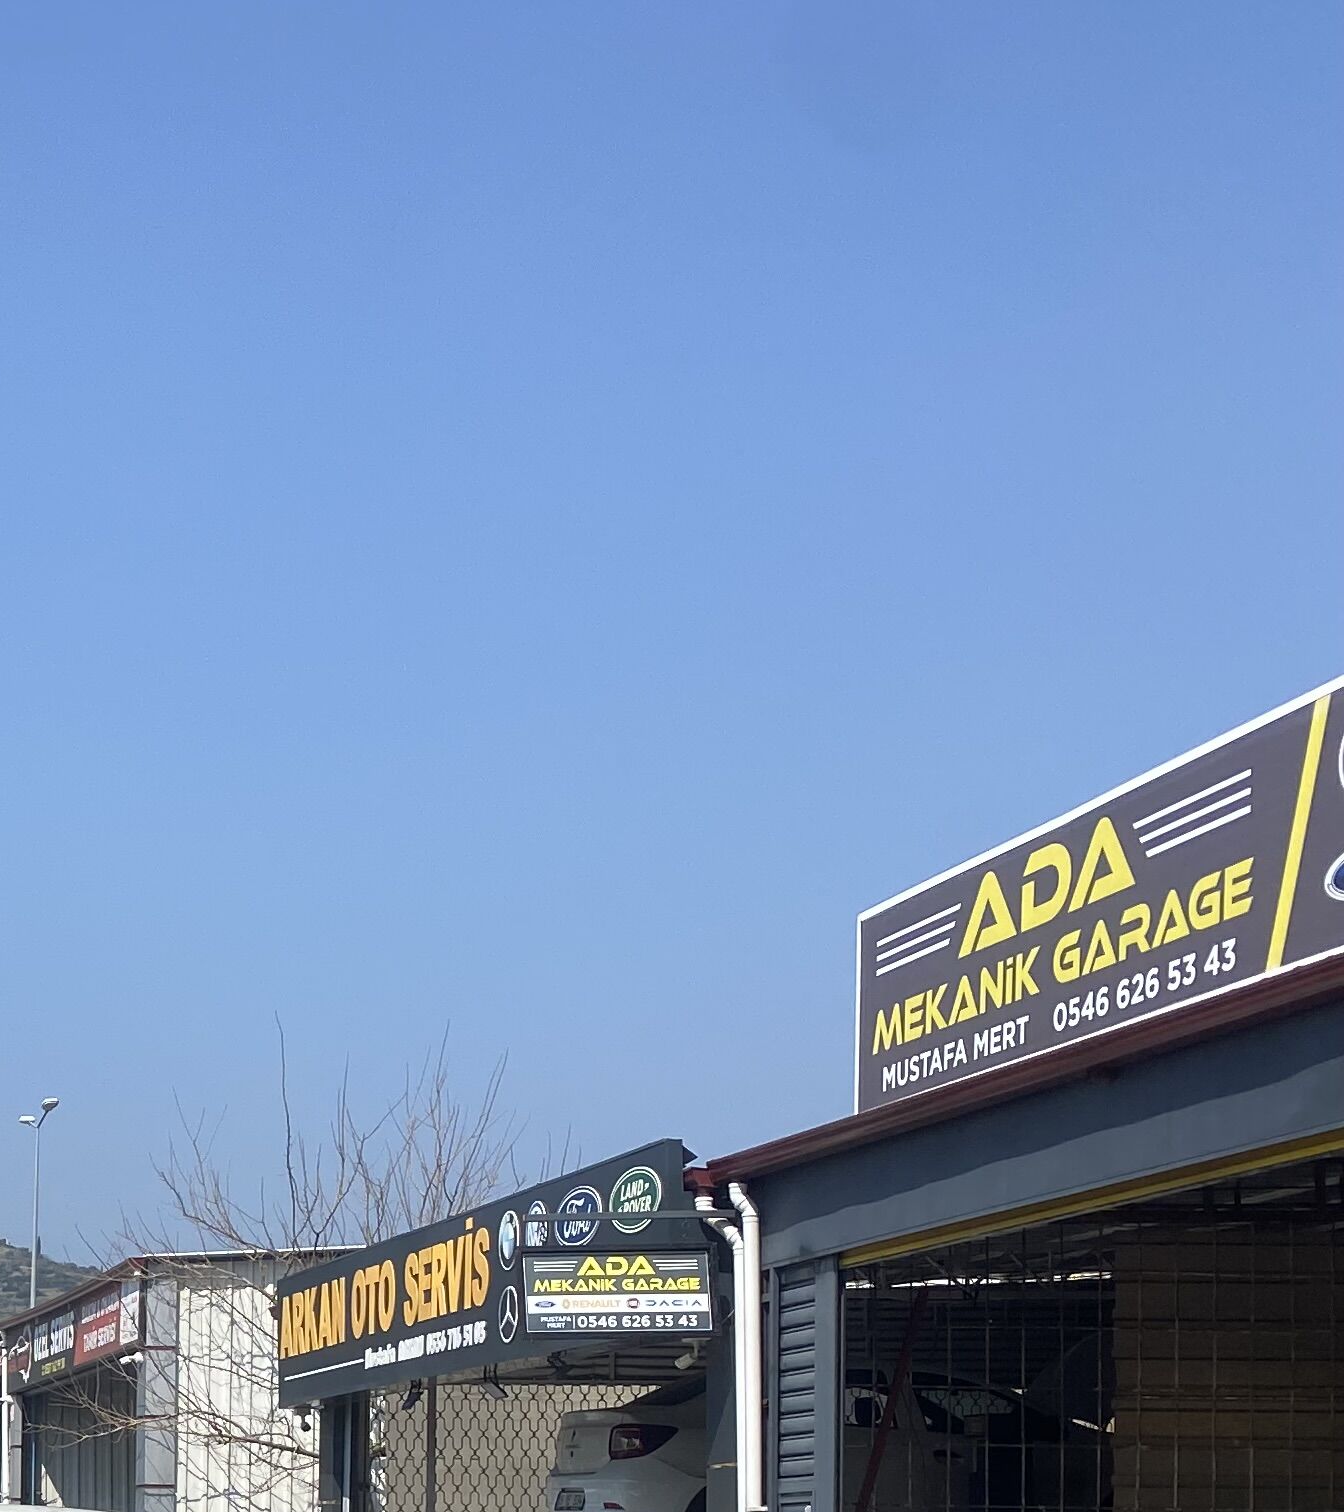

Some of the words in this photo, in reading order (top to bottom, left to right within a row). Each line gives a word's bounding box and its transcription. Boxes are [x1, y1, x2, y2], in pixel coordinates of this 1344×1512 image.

[958, 817, 1136, 958] ADA
[1053, 857, 1254, 984] GARAGE
[882, 1038, 968, 1092] MUSTAFA
[973, 1015, 1030, 1061] MERT
[1053, 985, 1110, 1032] 0546
[1116, 973, 1160, 1010] 626
[1167, 953, 1196, 992] 53
[1203, 937, 1237, 975] 43
[620, 1179, 644, 1202] LAND
[577, 1255, 656, 1276] ADA
[280, 1277, 346, 1361] ARKAN
[351, 1259, 396, 1340] OTO
[403, 1217, 491, 1327] SERVİS
[622, 1277, 701, 1292] GARAGE
[572, 1299, 621, 1309] RENAULT
[645, 1299, 703, 1308] DACIA
[577, 1315, 618, 1329] 0546
[622, 1315, 651, 1328] 626
[655, 1315, 674, 1328] 53
[678, 1314, 698, 1327] 43
